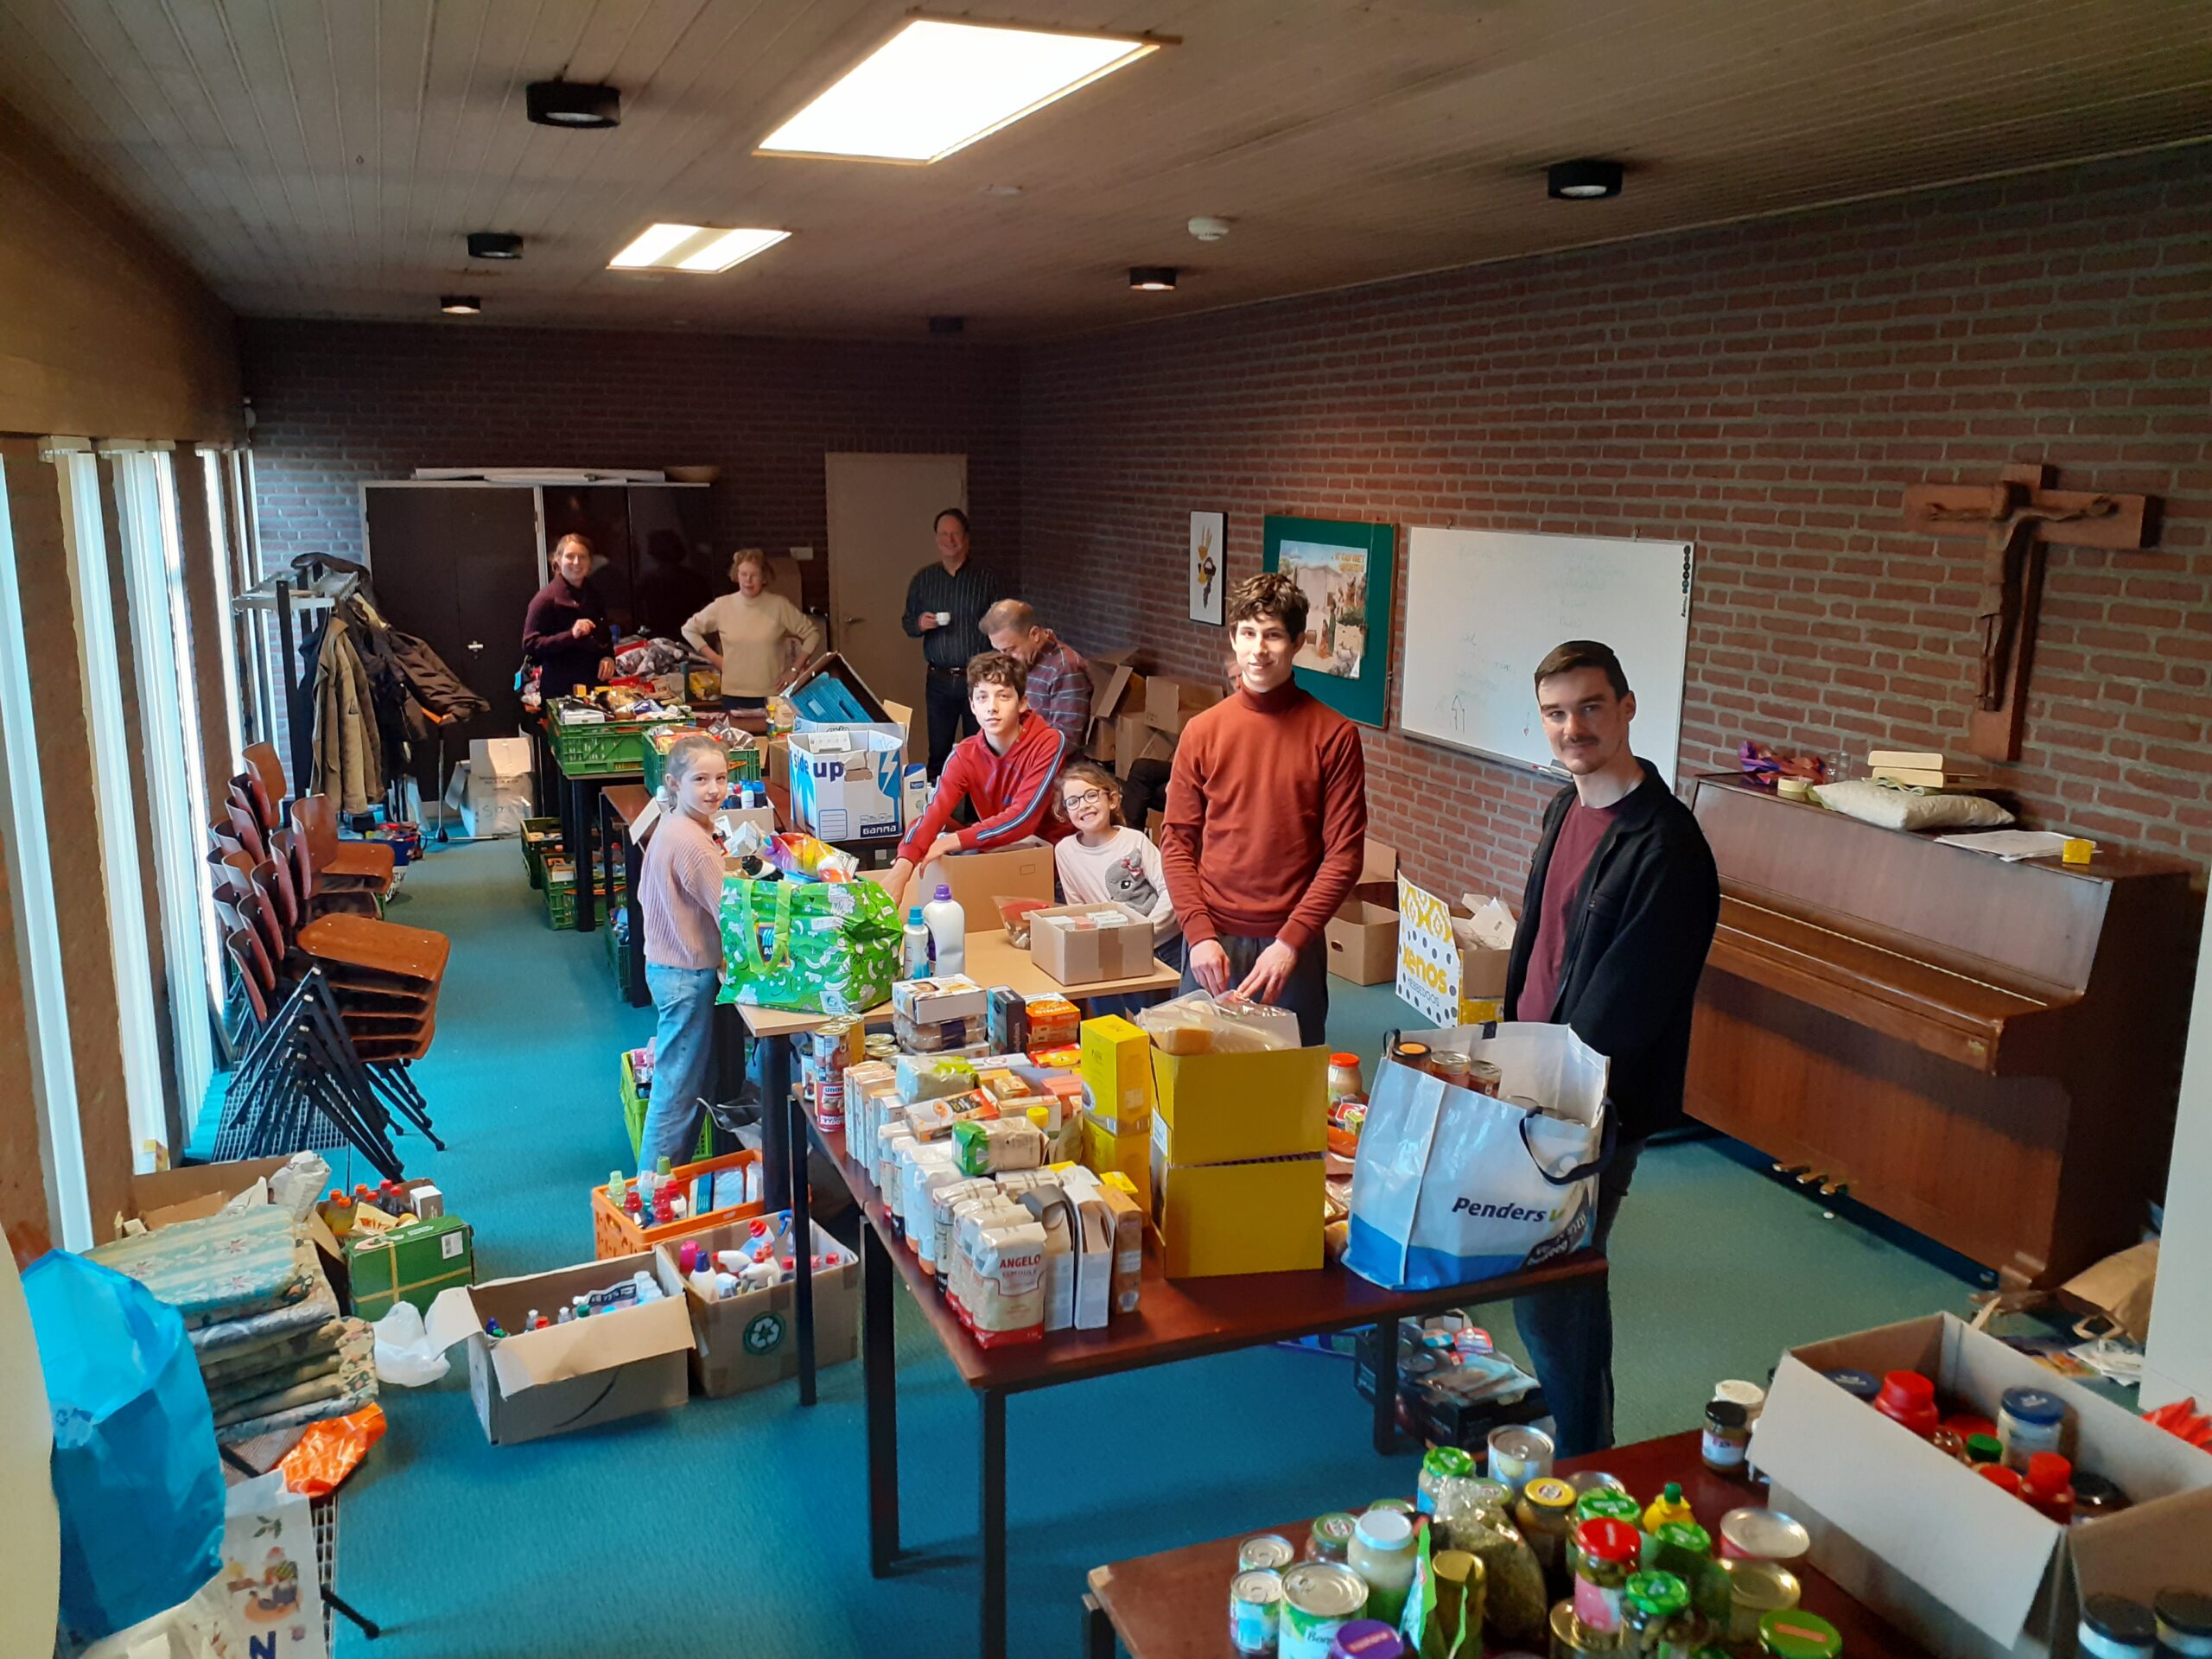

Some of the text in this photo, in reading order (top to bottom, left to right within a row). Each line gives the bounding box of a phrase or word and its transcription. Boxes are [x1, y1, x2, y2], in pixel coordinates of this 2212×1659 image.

[813, 760, 844, 782] up
[1402, 942, 1448, 995] xenos
[1452, 1197, 1547, 1223] Penders
[999, 1254, 1041, 1268] ANGELO
